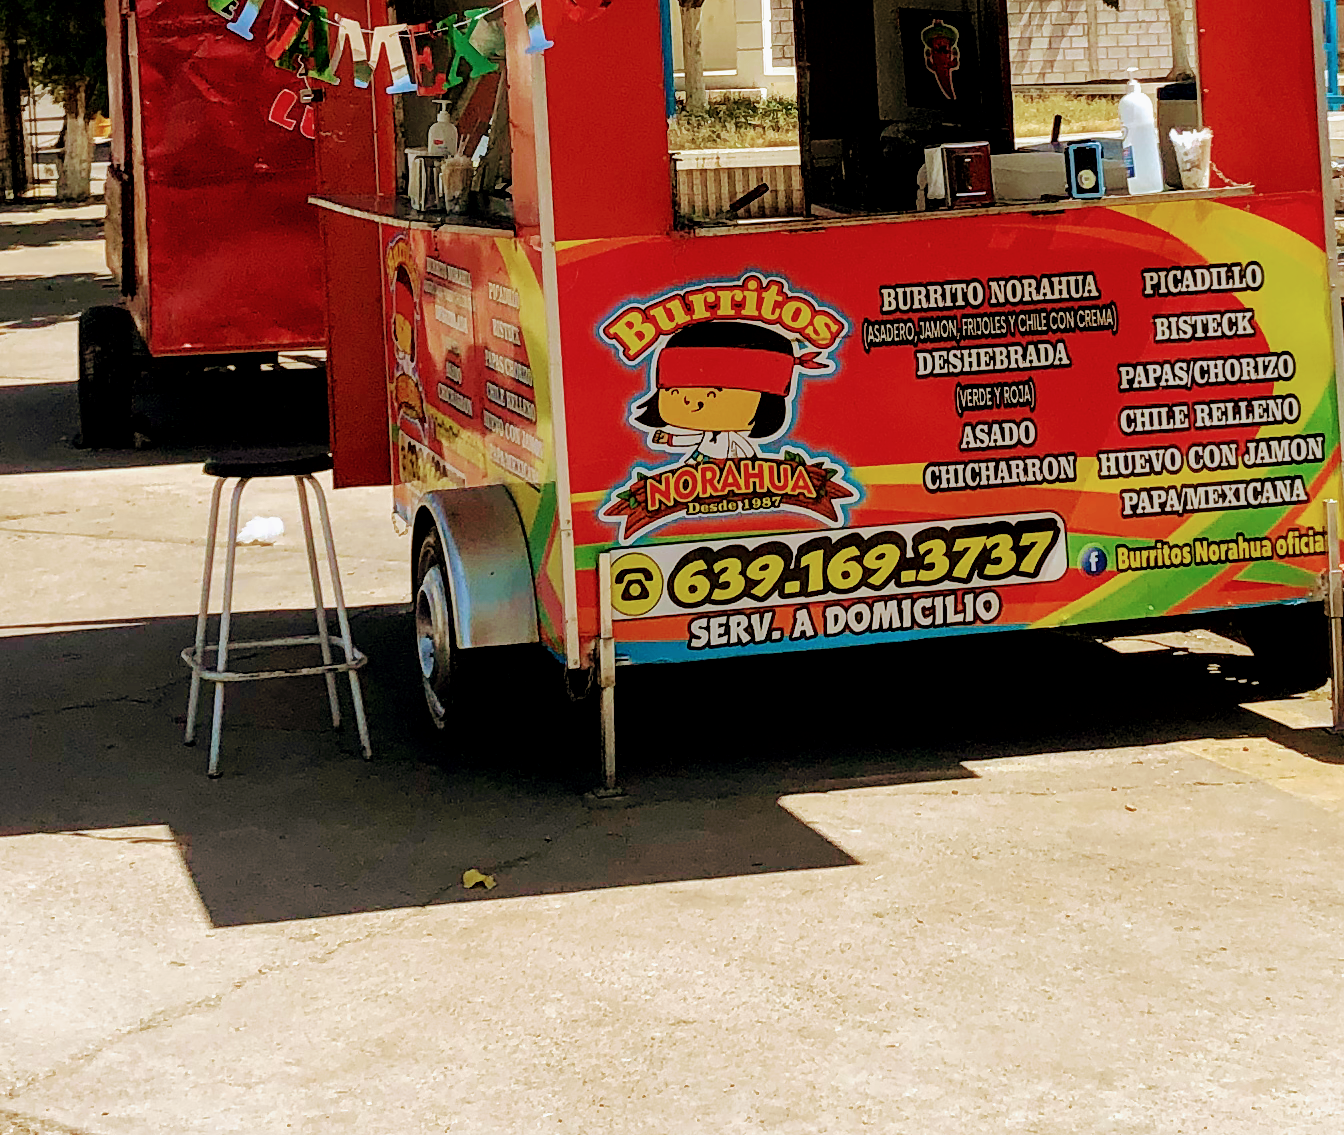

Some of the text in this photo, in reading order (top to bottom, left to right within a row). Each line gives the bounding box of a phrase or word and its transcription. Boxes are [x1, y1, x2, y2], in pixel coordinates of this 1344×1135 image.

[881, 274, 1100, 312] BURRITO NORAHUA
[1143, 264, 1263, 295] PICADILLO
[608, 278, 840, 357] Burritos
[863, 304, 1119, 350] (ASADERO, JAMON, FRIJOLES Y CHILE CON CREMA)
[1154, 312, 1255, 341] BISTECK
[916, 342, 1071, 376] DESHEBRADA
[1118, 354, 1295, 390] PAPAS/CHORIZO
[956, 381, 1035, 414] (VERDE Y ROJA)
[1120, 397, 1300, 434] CHILE RELLENO
[960, 421, 1036, 450] ASADO
[924, 455, 1076, 491] CHICHARRON
[1098, 436, 1325, 477] HUEVO CON JAMON
[647, 460, 817, 512] NORAHUA
[1121, 478, 1308, 515] PAPA/MEXICANA
[686, 496, 782, 515] Desde 1987
[670, 529, 1058, 605] 639.169.3737
[1117, 542, 1192, 571] Burritos
[1194, 537, 1273, 566] Norahua
[688, 592, 1001, 650] SERV. A DOMICILIO
